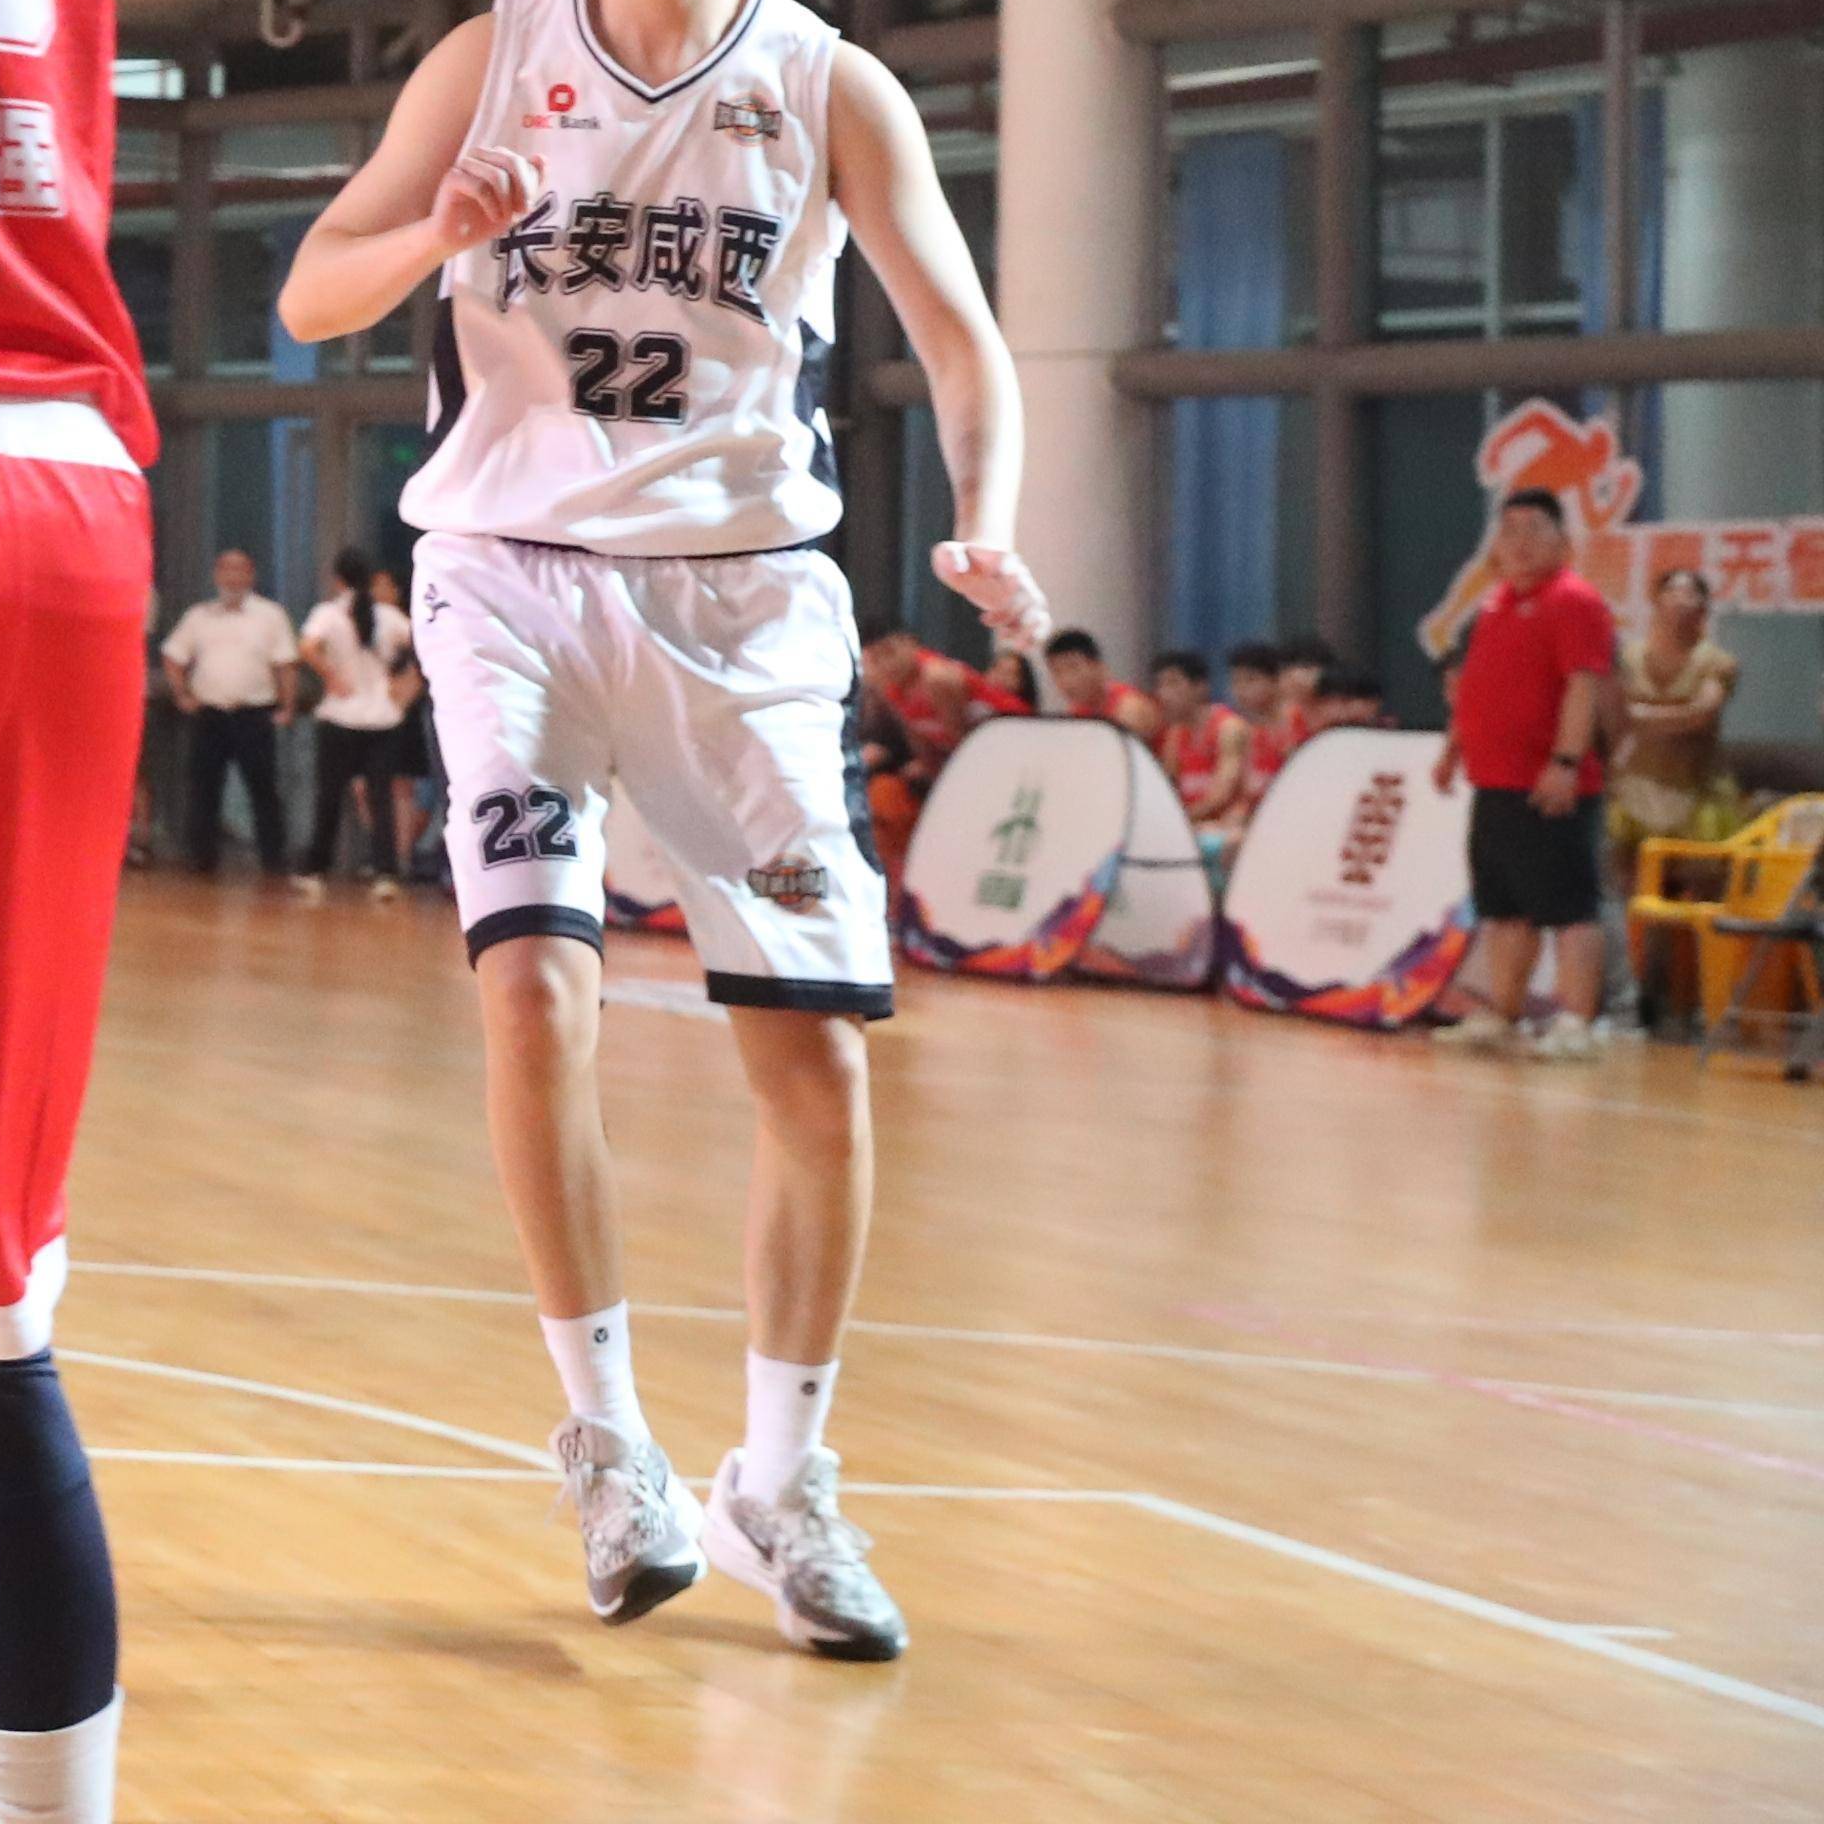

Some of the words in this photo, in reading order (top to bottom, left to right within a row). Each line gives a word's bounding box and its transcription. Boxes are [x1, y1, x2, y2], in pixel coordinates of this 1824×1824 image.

[559, 113, 602, 129] Bank
[491, 190, 784, 326] 长安咸西
[564, 327, 691, 425] 22
[471, 784, 582, 870] 22
